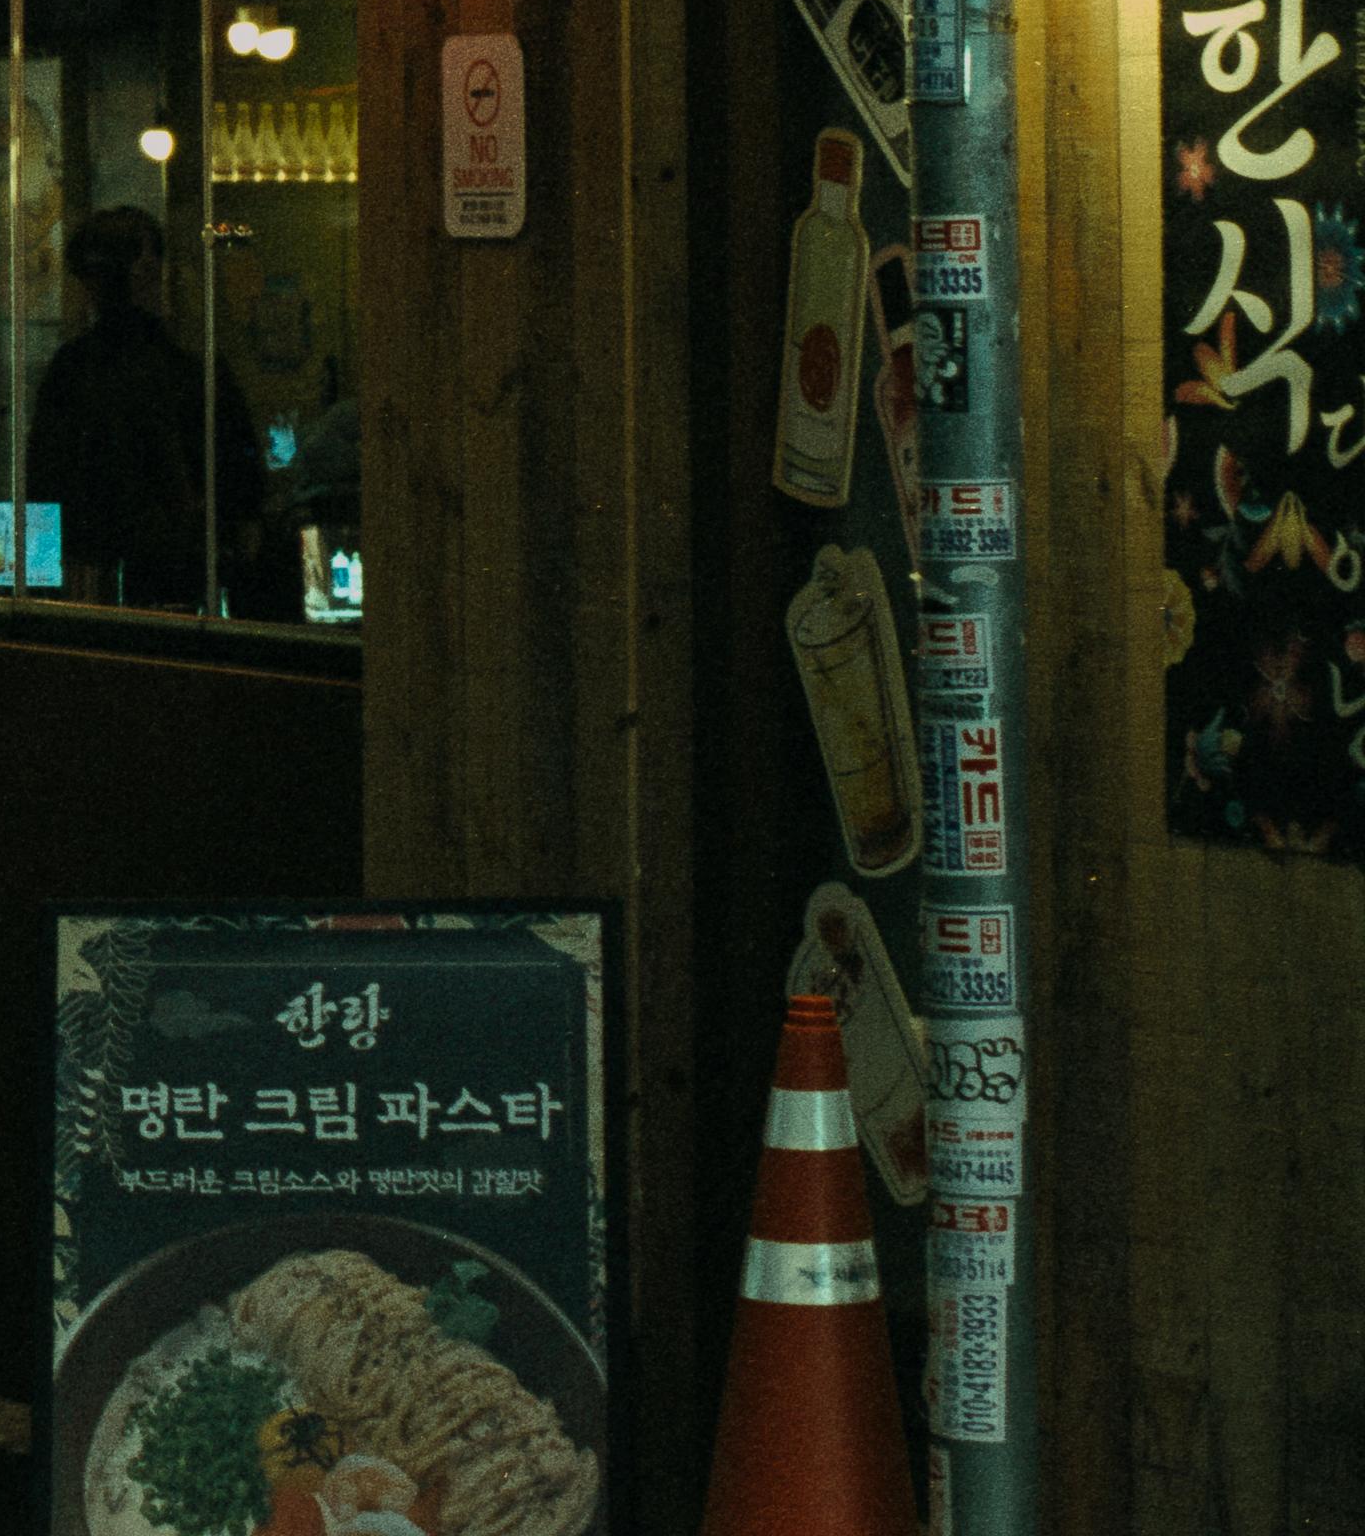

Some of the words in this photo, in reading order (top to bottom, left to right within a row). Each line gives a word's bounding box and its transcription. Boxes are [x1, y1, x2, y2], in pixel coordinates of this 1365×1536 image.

[469, 132, 499, 164] NO
[452, 166, 514, 189] SMOKING
[119, 1081, 230, 1141] 명란
[242, 1081, 360, 1141] 크림
[375, 1080, 566, 1141] 파스타
[120, 1166, 225, 1196] 부드러운
[229, 1166, 363, 1196] 크림소스와
